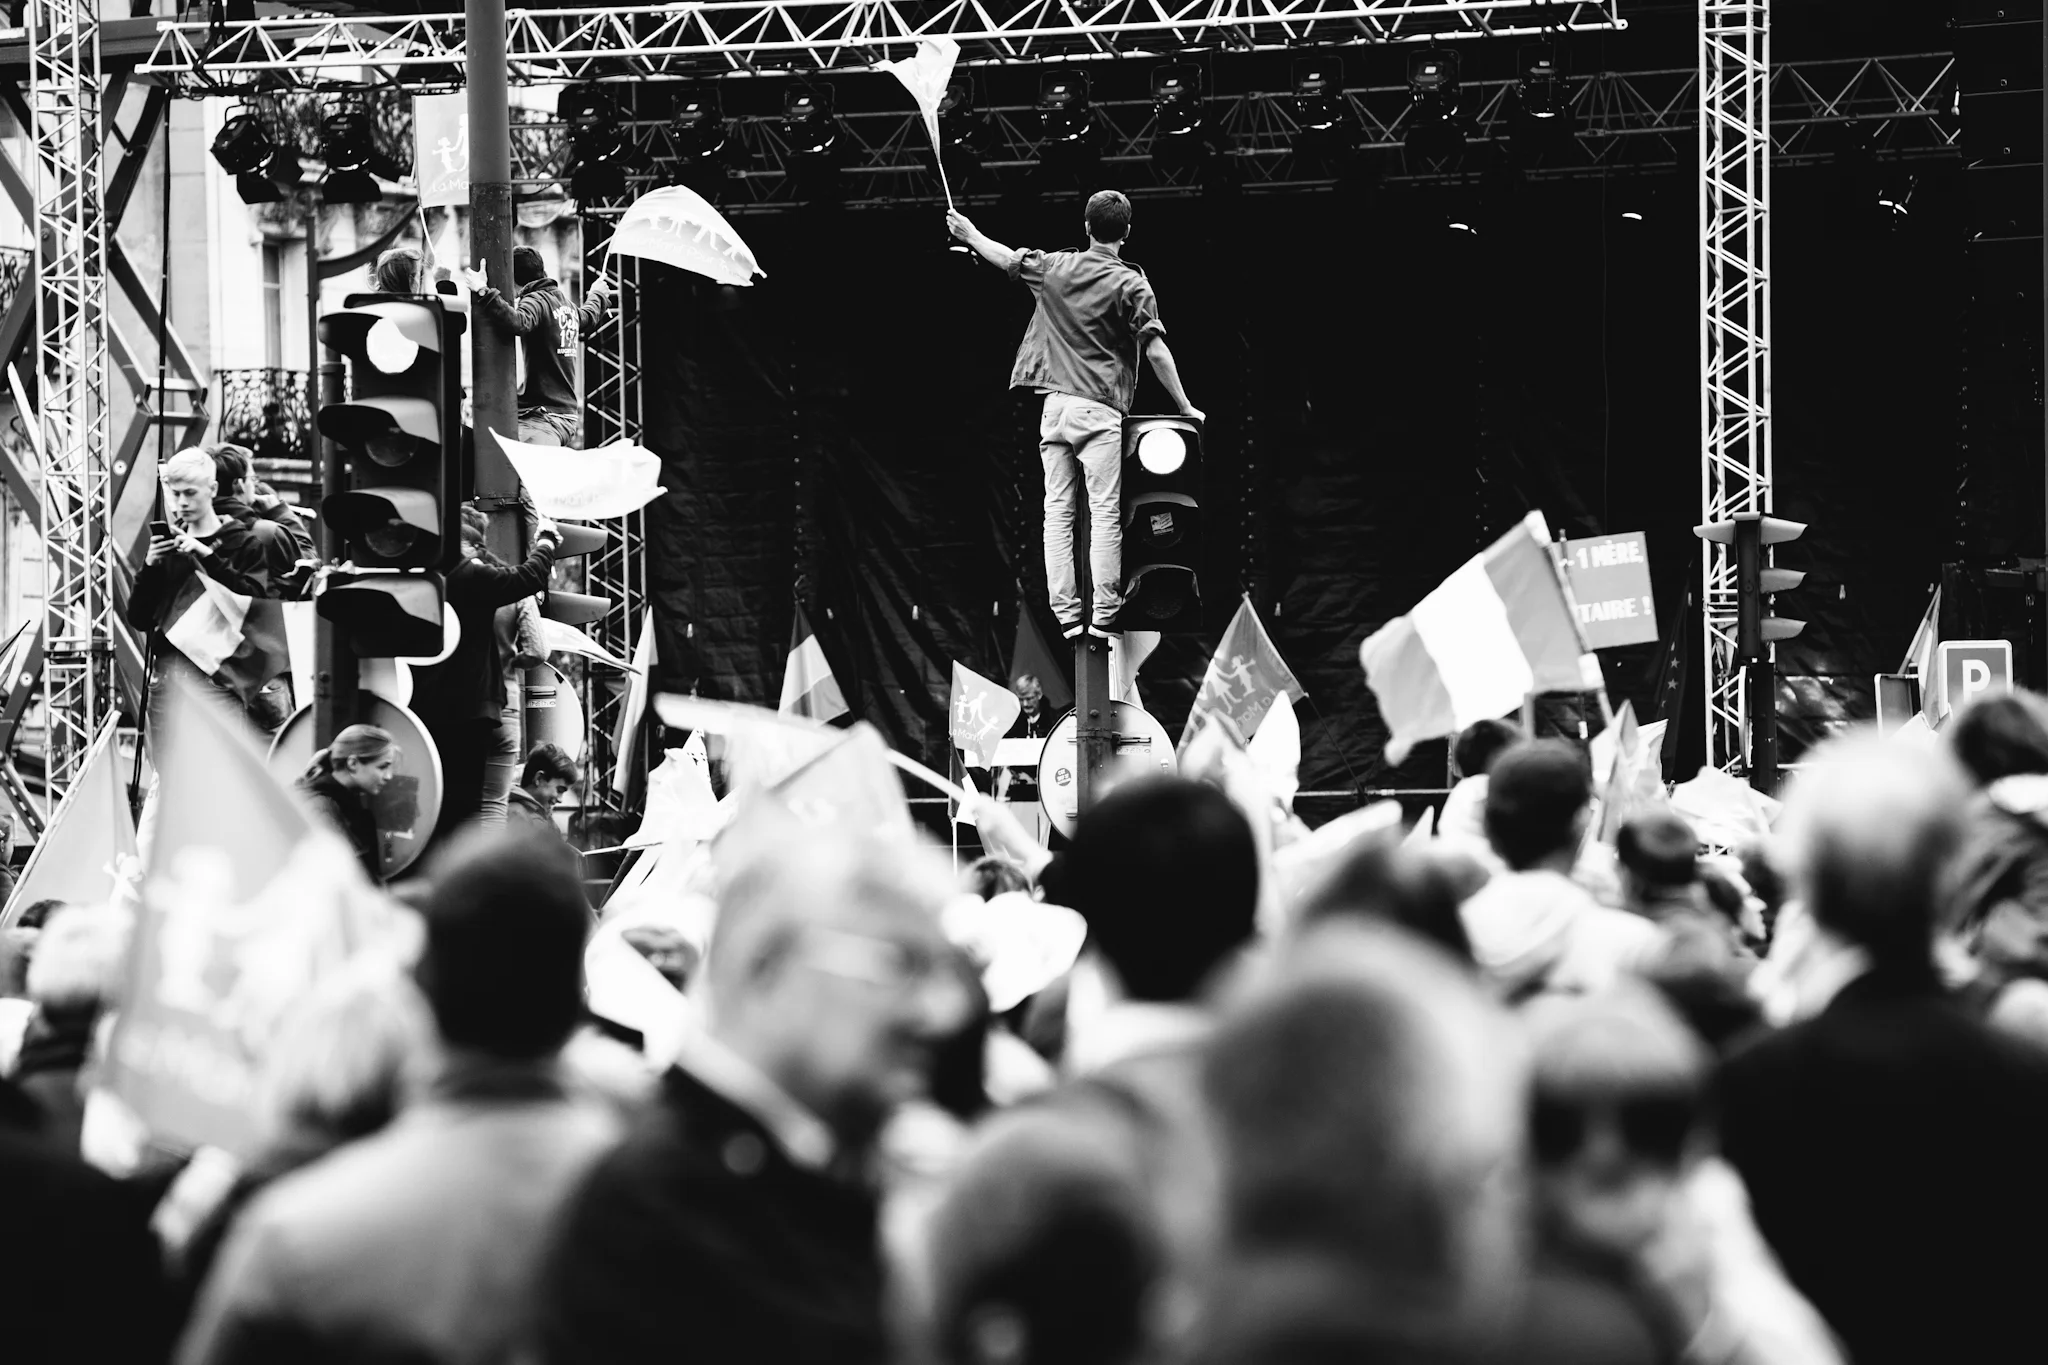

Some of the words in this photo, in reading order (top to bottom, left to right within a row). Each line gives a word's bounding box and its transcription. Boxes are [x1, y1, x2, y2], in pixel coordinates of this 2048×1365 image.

[449, 178, 468, 191] Ma
[1576, 547, 1589, 570] 1
[1577, 597, 1640, 623] TAIRE
[1962, 659, 1991, 704] P
